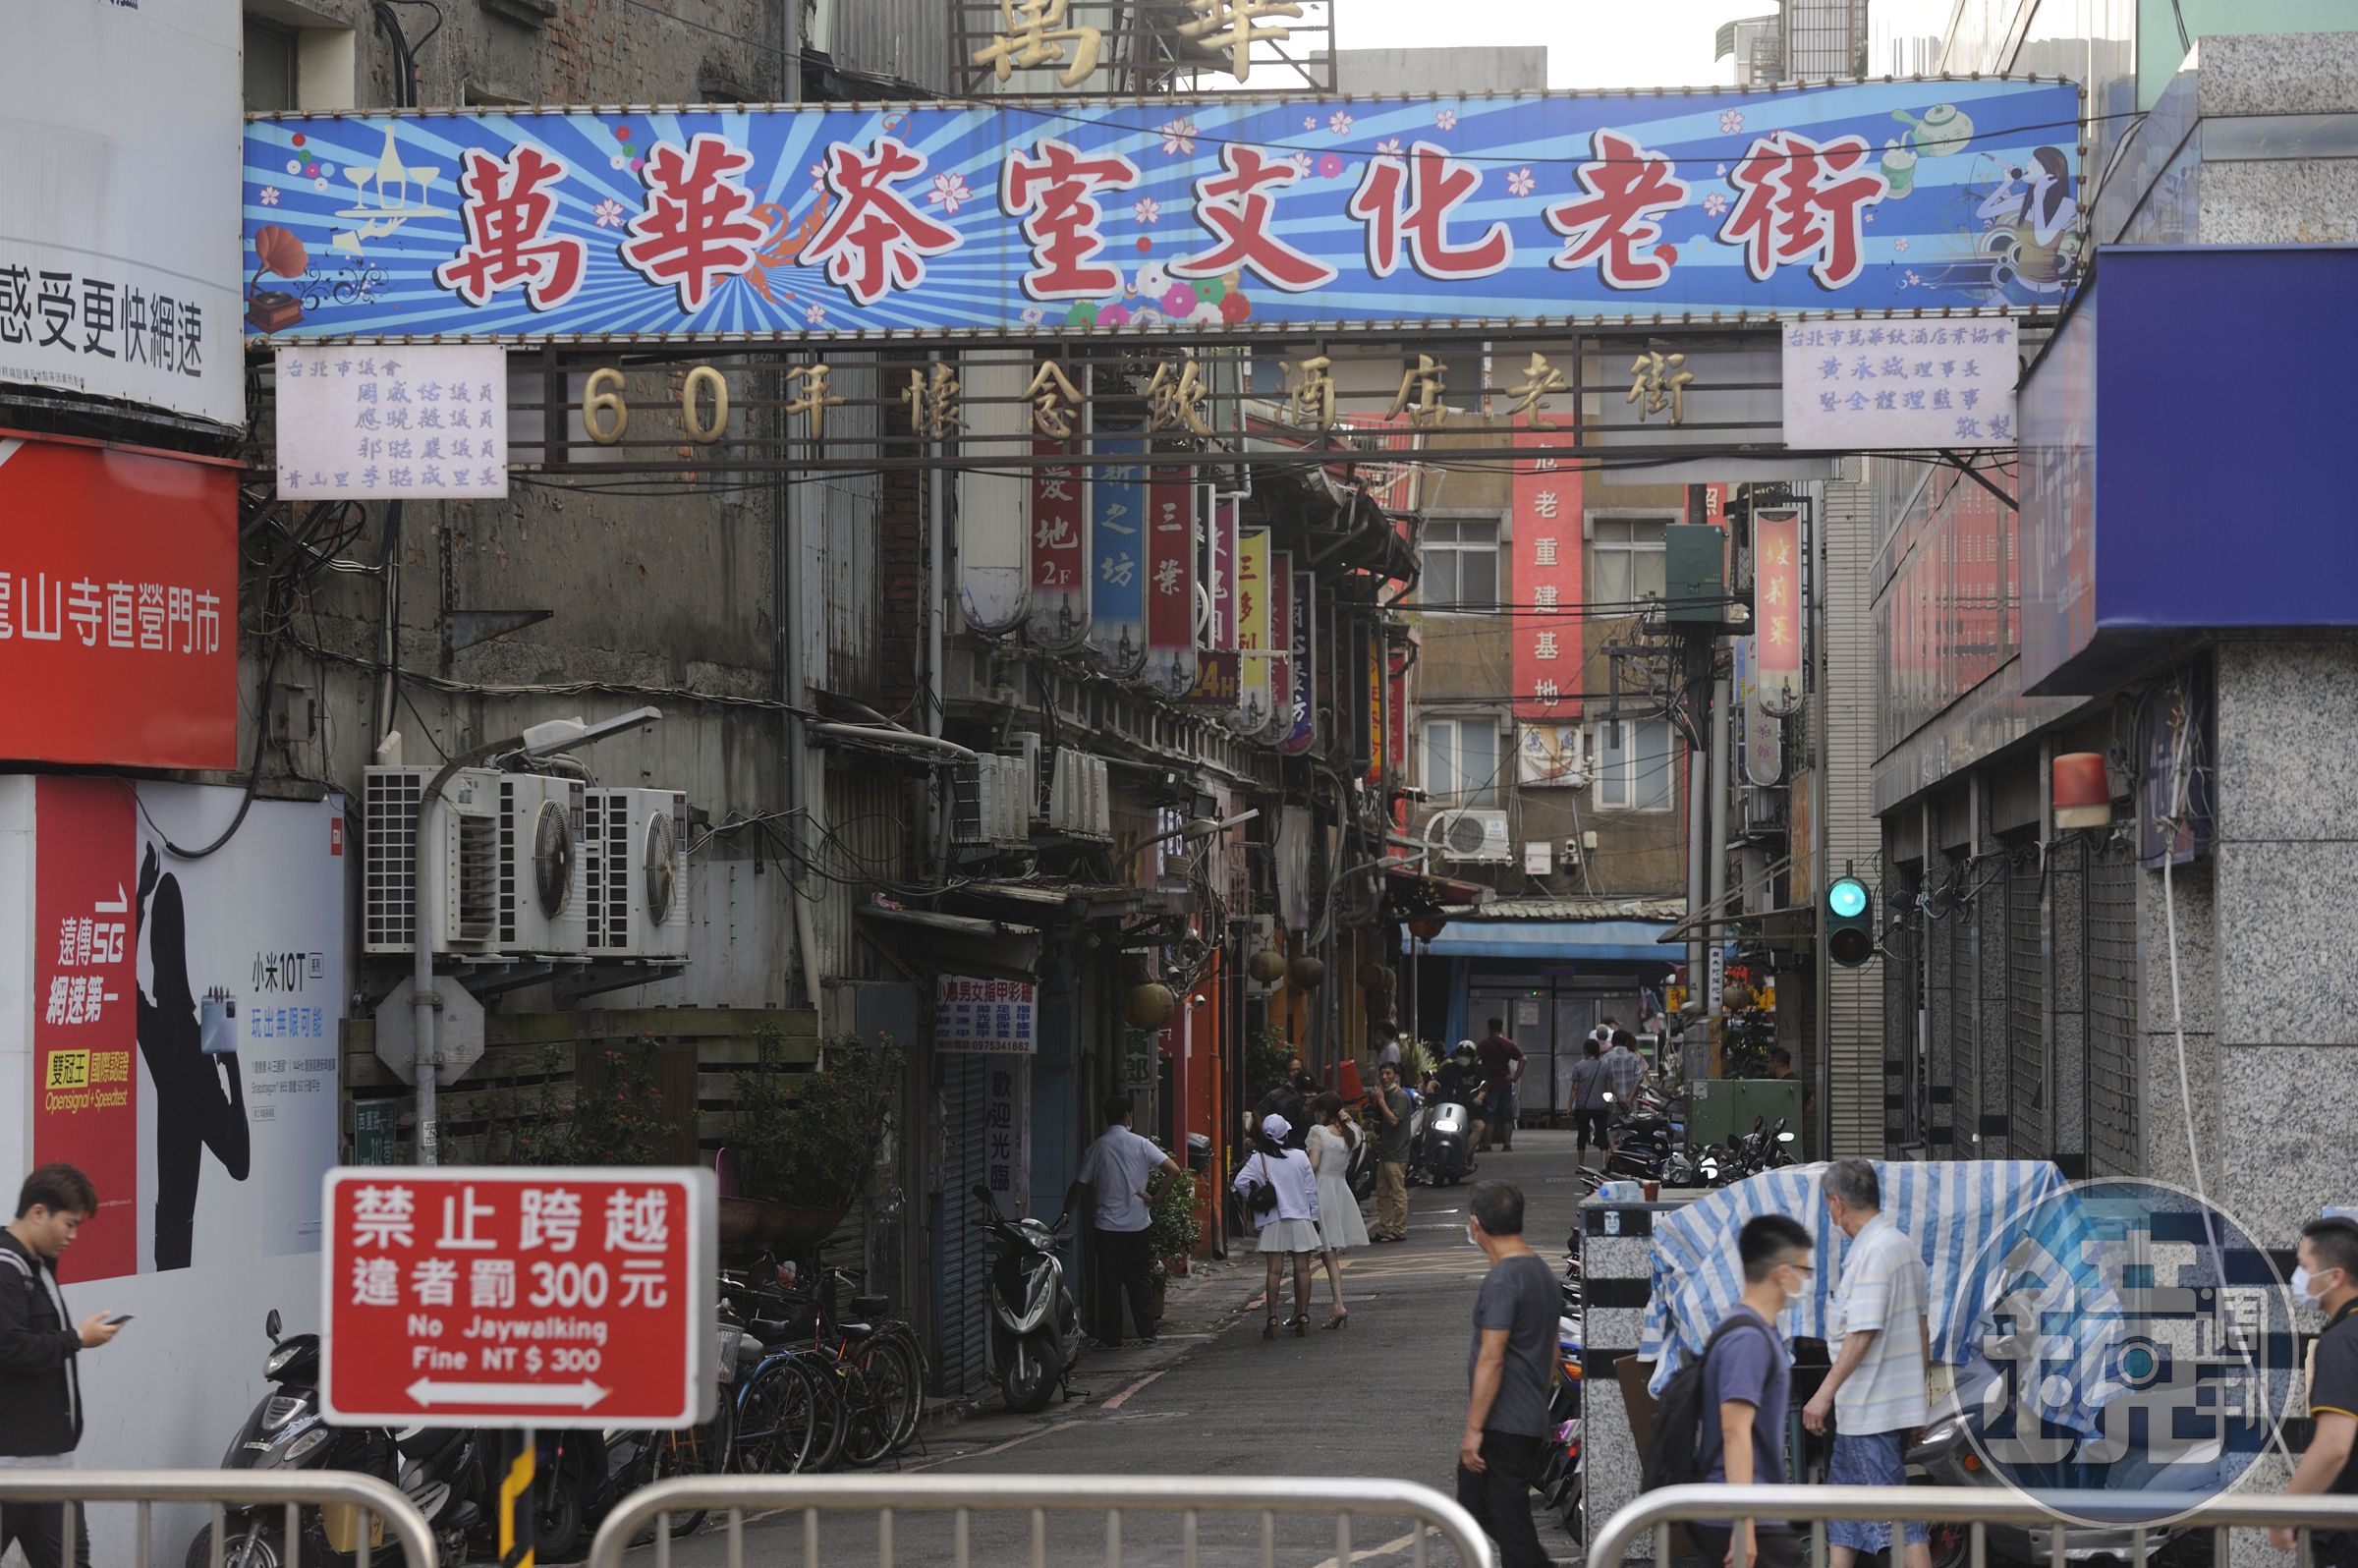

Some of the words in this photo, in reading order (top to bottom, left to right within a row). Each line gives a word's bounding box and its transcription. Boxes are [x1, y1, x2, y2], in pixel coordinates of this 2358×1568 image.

[438, 130, 1890, 311] 萬華茶室文化老街
[0, 263, 202, 378] 感受更快網速
[287, 358, 402, 377] 台北市議會
[1099, 451, 1137, 588] 新之坊
[1152, 502, 1185, 594] 三葉
[1534, 443, 1559, 707] 危老重建基地
[46, 975, 119, 1026] 網速第一
[252, 1006, 323, 1038] 玩出無限可能
[51, 1053, 85, 1086] 雙冠王
[352, 1185, 669, 1254] 禁止跨越
[407, 1314, 444, 1338] No
[463, 1315, 608, 1347] Jaywalking
[412, 1346, 469, 1371] Fine
[550, 1348, 601, 1372] 300
